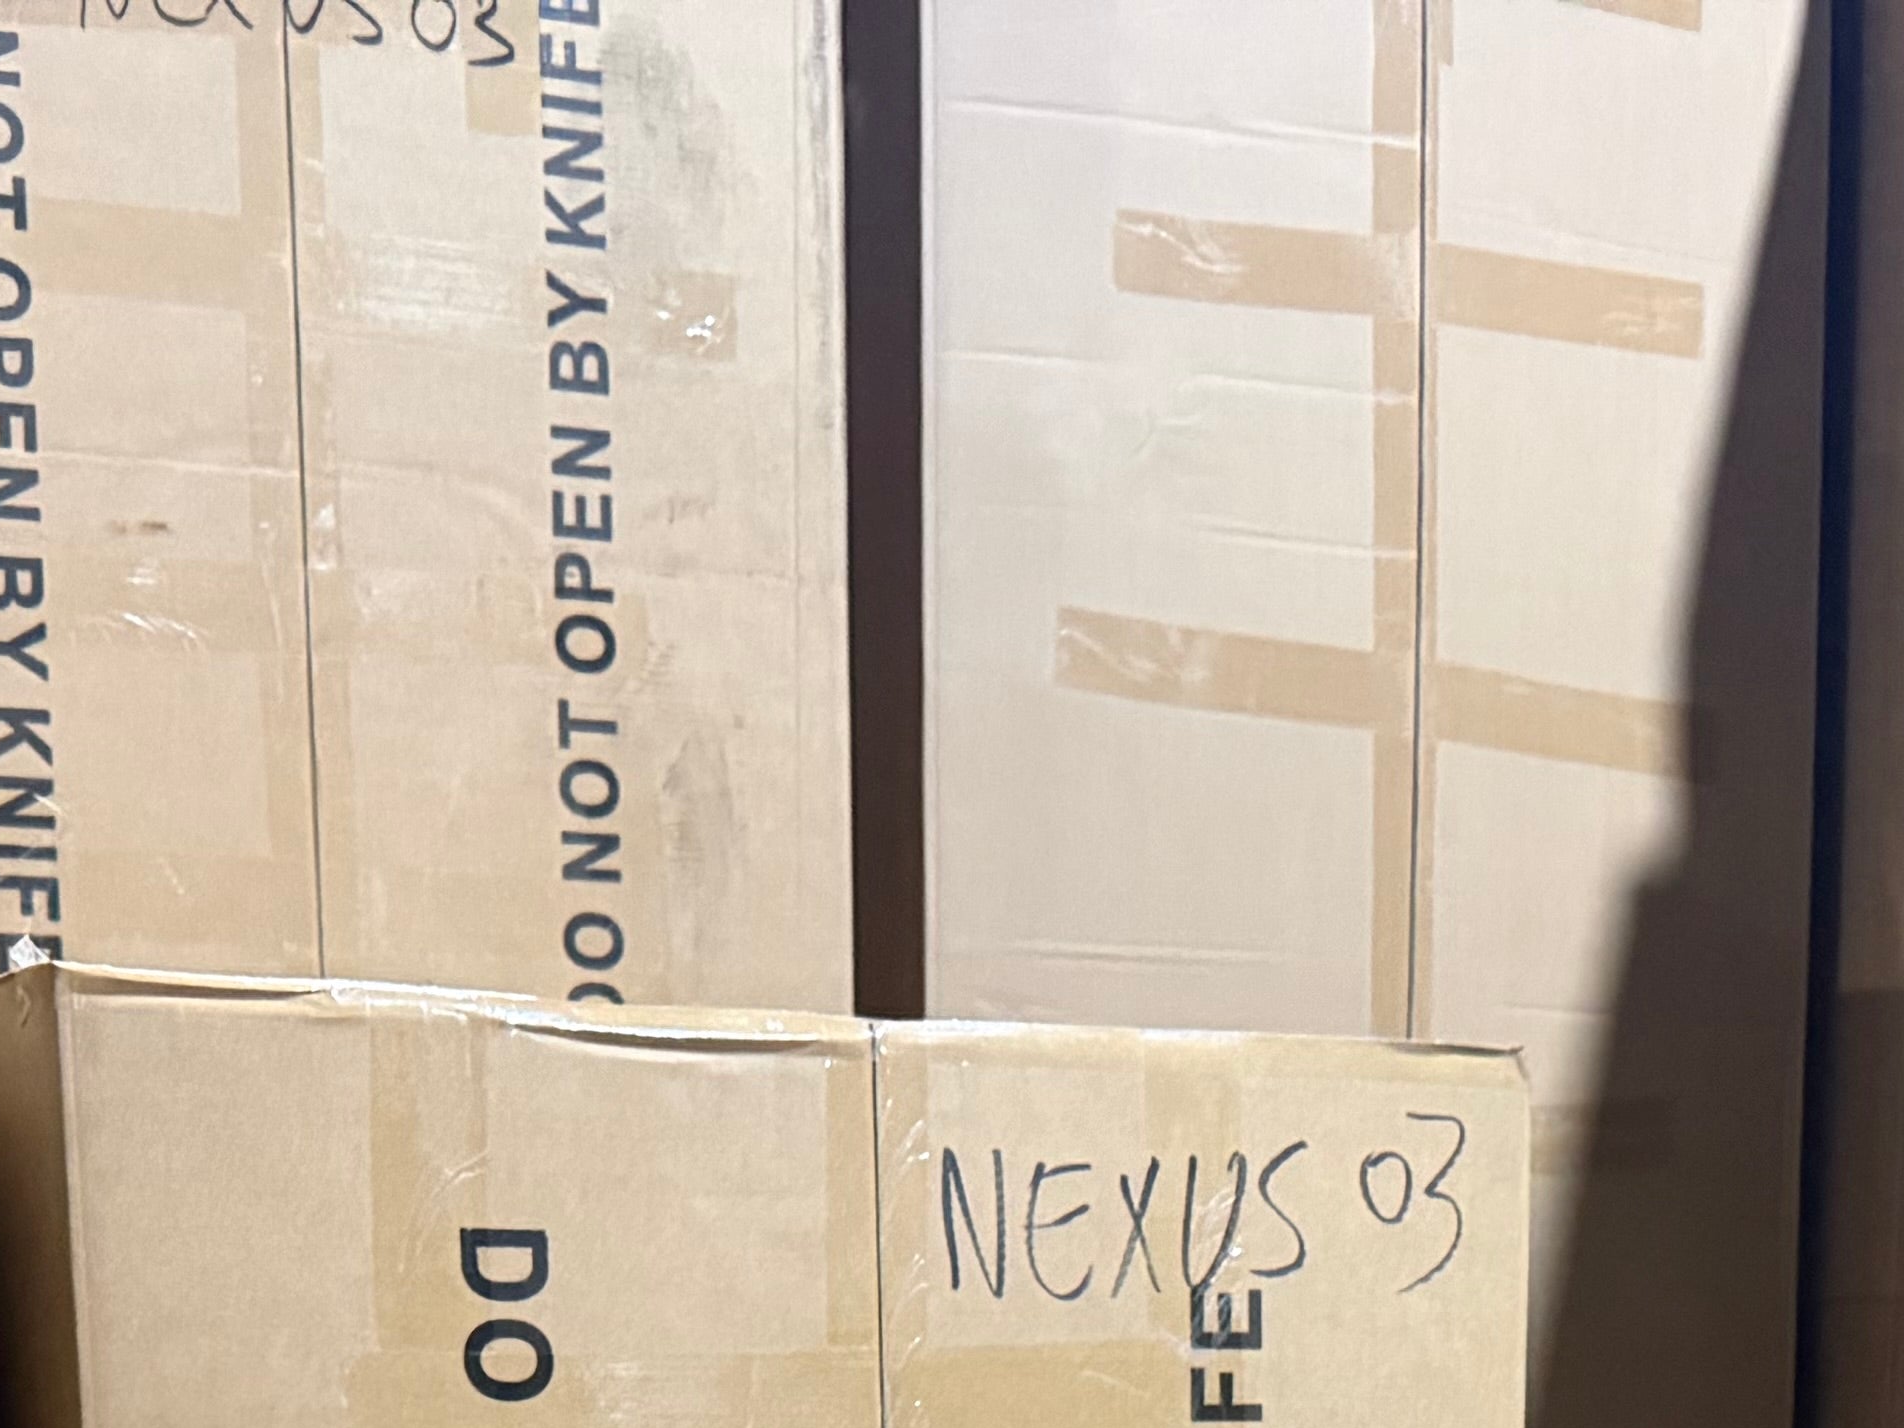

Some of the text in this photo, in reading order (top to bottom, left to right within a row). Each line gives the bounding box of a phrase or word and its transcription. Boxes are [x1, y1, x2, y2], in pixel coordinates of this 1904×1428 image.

[547, 270, 610, 396] BY
[551, 426, 617, 675] OPEN
[557, 700, 622, 883] NOT
[941, 1112, 1466, 1301] NEXUS 03
[459, 1228, 554, 1401] DO
